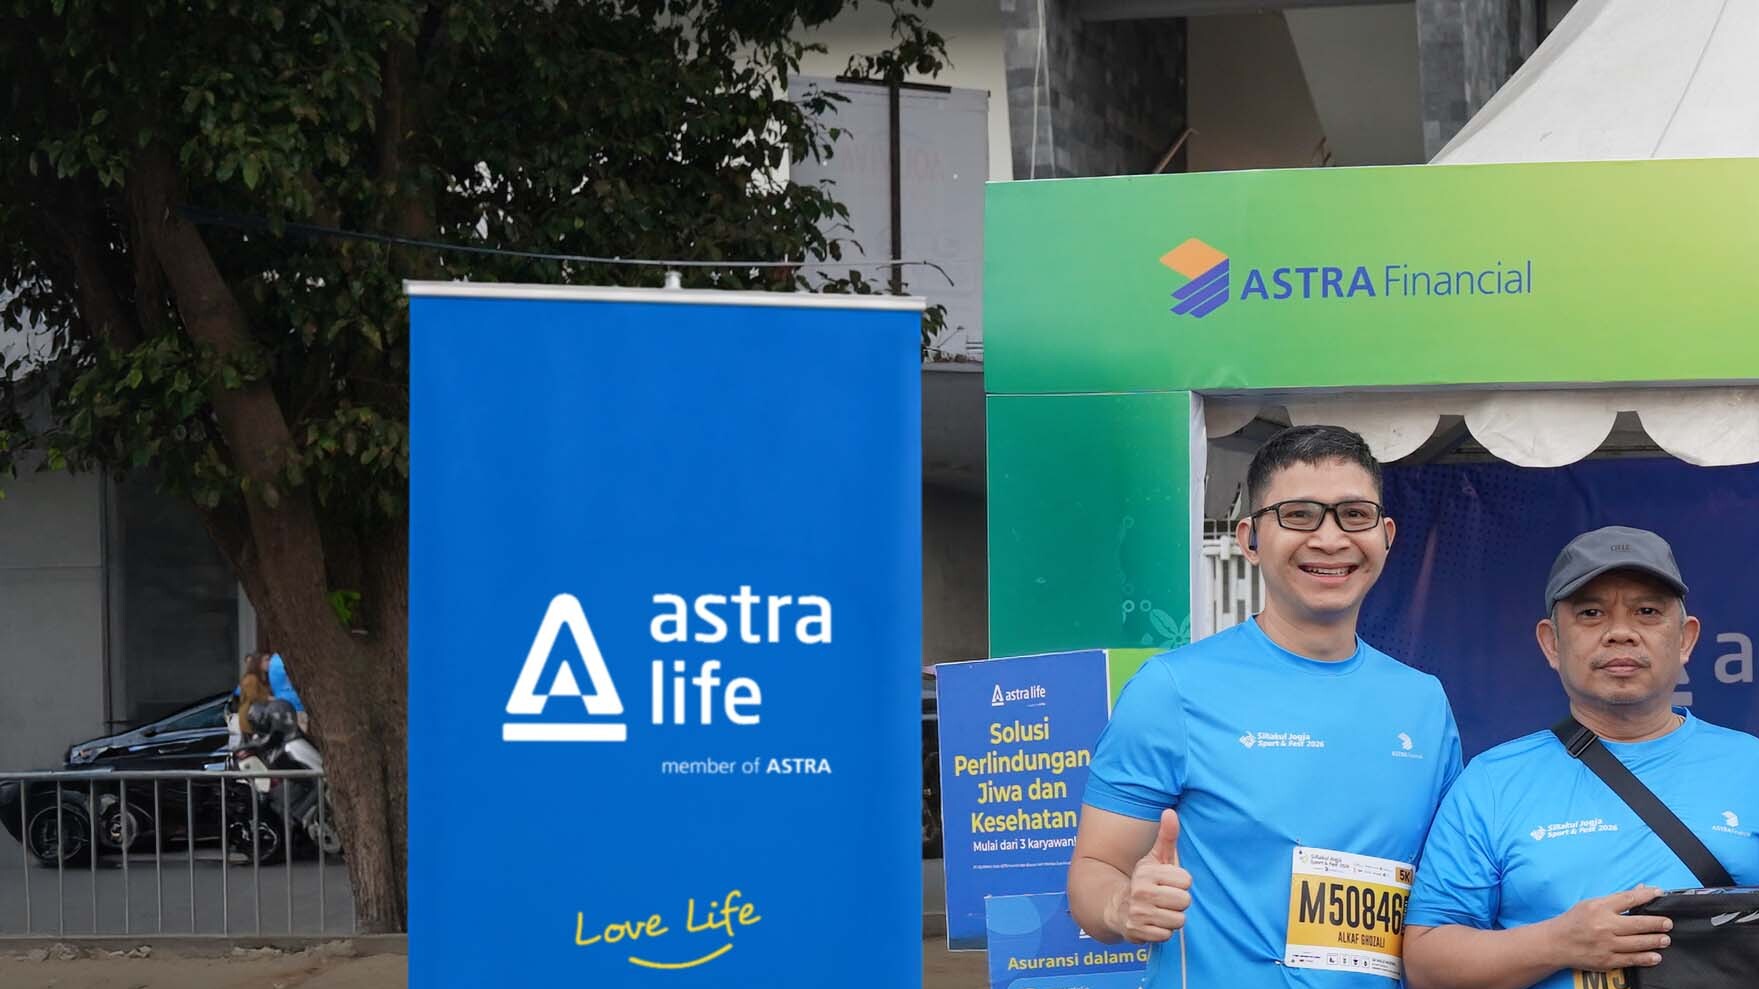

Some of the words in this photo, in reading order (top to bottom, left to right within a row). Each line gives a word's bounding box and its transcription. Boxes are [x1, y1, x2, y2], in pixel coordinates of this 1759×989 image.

[1240, 265, 1377, 301] ASTRA
[1385, 260, 1532, 298] Financial
[649, 585, 833, 644] astra
[651, 660, 762, 725] life
[1005, 688, 1029, 701] astra
[1030, 685, 1046, 699] life
[990, 716, 1050, 745] Solusi
[662, 757, 735, 775] member
[741, 757, 760, 775] of
[766, 758, 832, 775] ASTRA
[954, 749, 1091, 777] Perlindungan
[977, 780, 1023, 804] Jiwa
[1028, 778, 1067, 800] dan
[971, 808, 1077, 833] Kesehatan
[973, 840, 998, 852] Mulai
[1000, 838, 1018, 850] dari
[1020, 838, 1026, 849] 3
[1028, 836, 1077, 850] karyawan!
[1400, 870, 1410, 882] 5K
[575, 911, 669, 945] Love
[686, 889, 762, 937] Life
[1299, 880, 1403, 935] M50846
[1338, 932, 1359, 944] ALKAF
[1007, 952, 1079, 971] Asuransi
[1083, 950, 1134, 967] dalam
